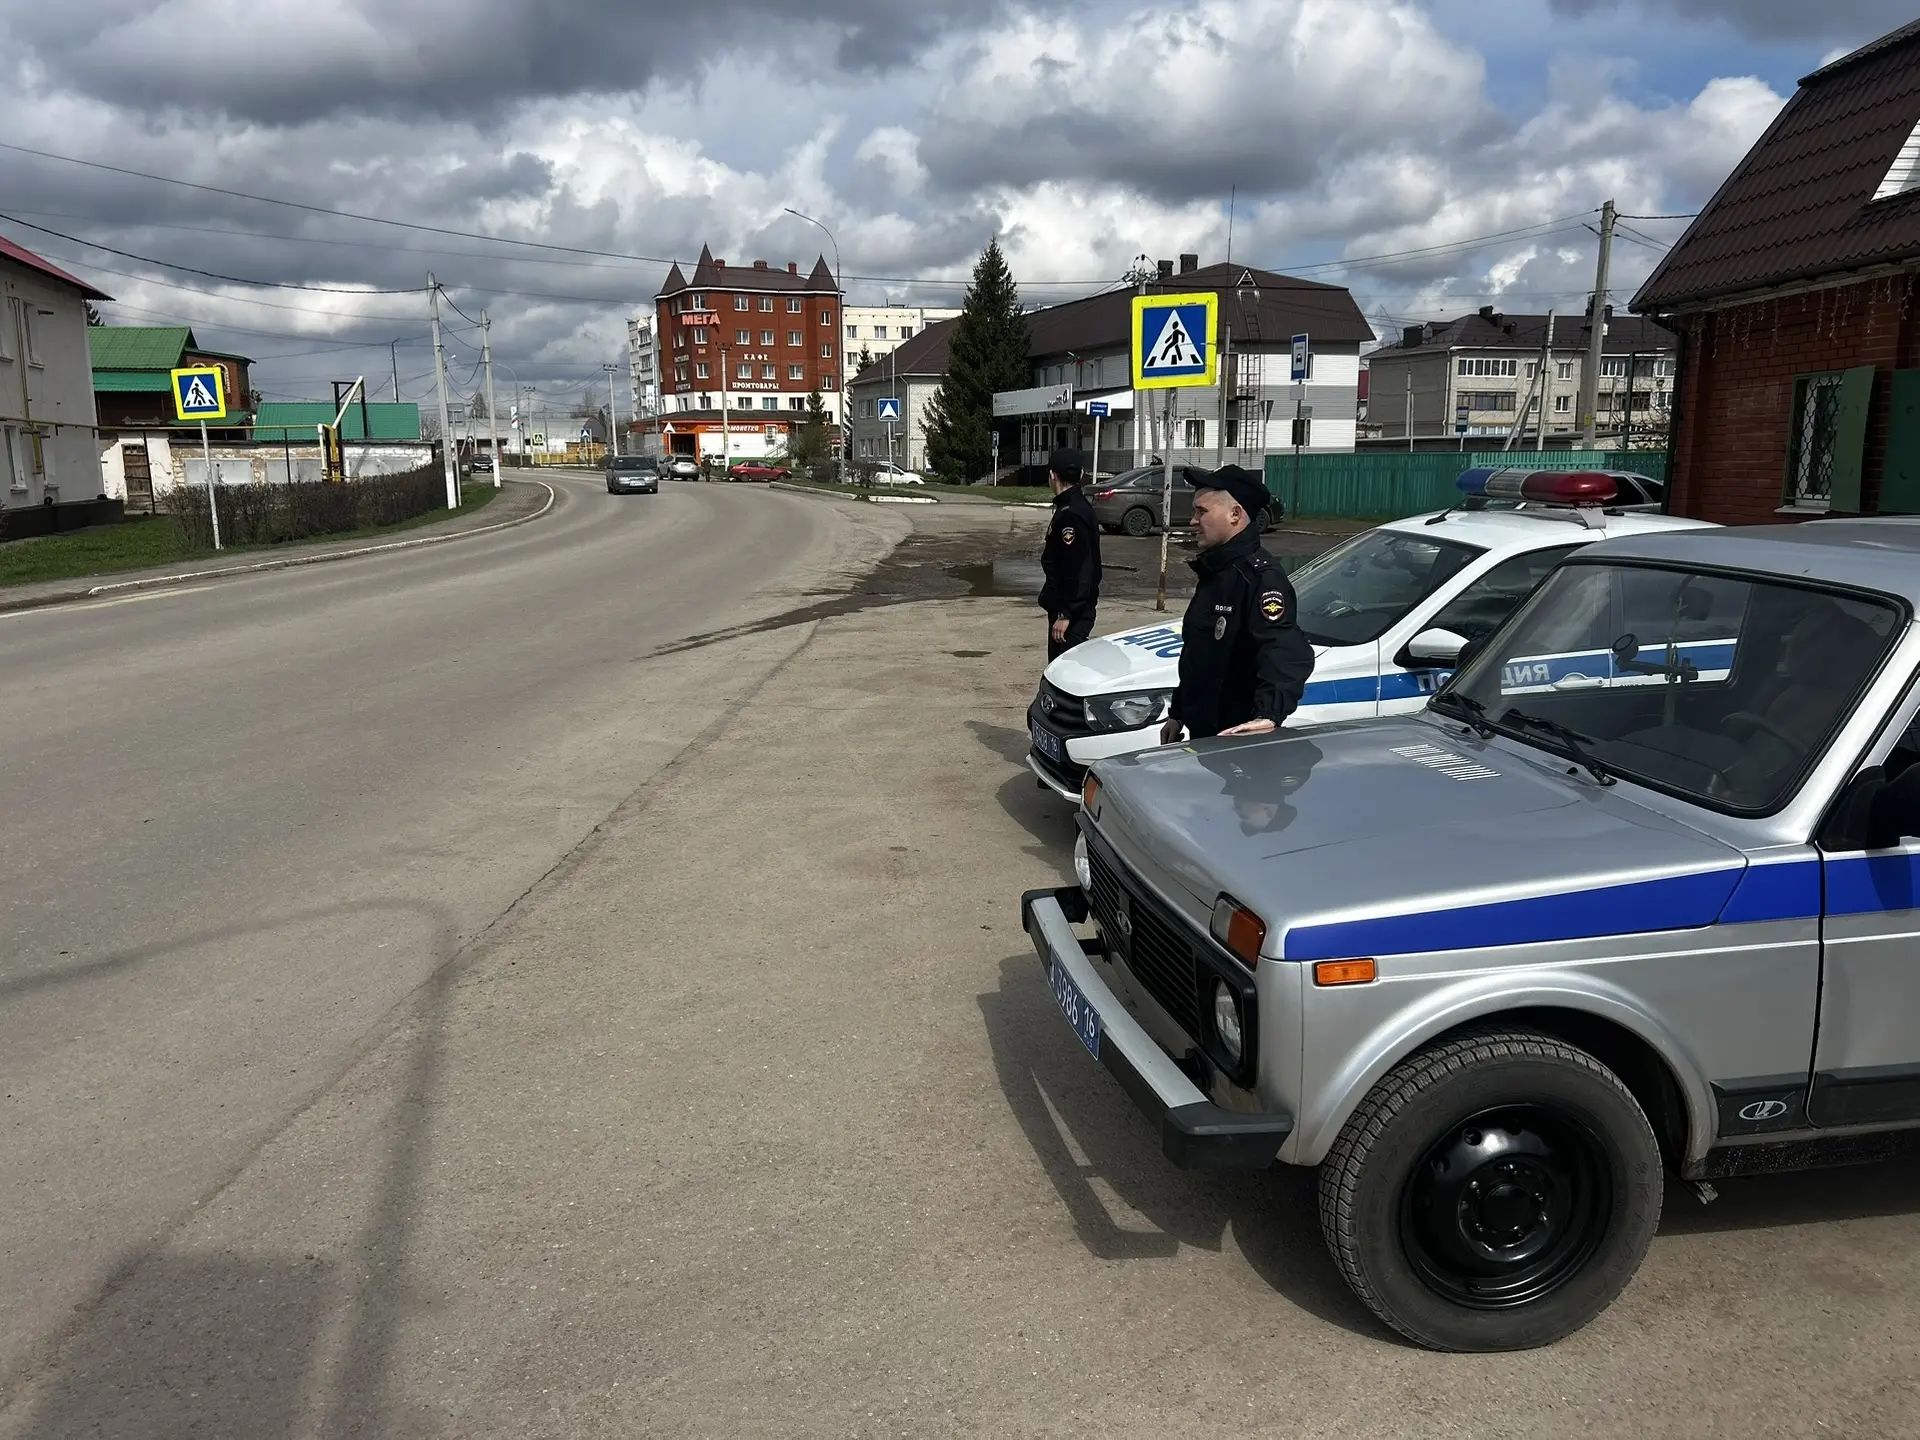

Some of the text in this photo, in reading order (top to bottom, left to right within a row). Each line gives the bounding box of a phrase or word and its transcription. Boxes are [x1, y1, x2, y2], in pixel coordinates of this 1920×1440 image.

[682, 313, 721, 326] МЕГА
[743, 353, 769, 361] КАФЕ
[731, 382, 780, 390] ПРОМТОВАРЫ
[1111, 628, 1185, 659] ДПС
[1416, 663, 1551, 692] ПОЦИЯ
[1057, 968, 1079, 1026] 3986
[1084, 1006, 1096, 1038] 16
